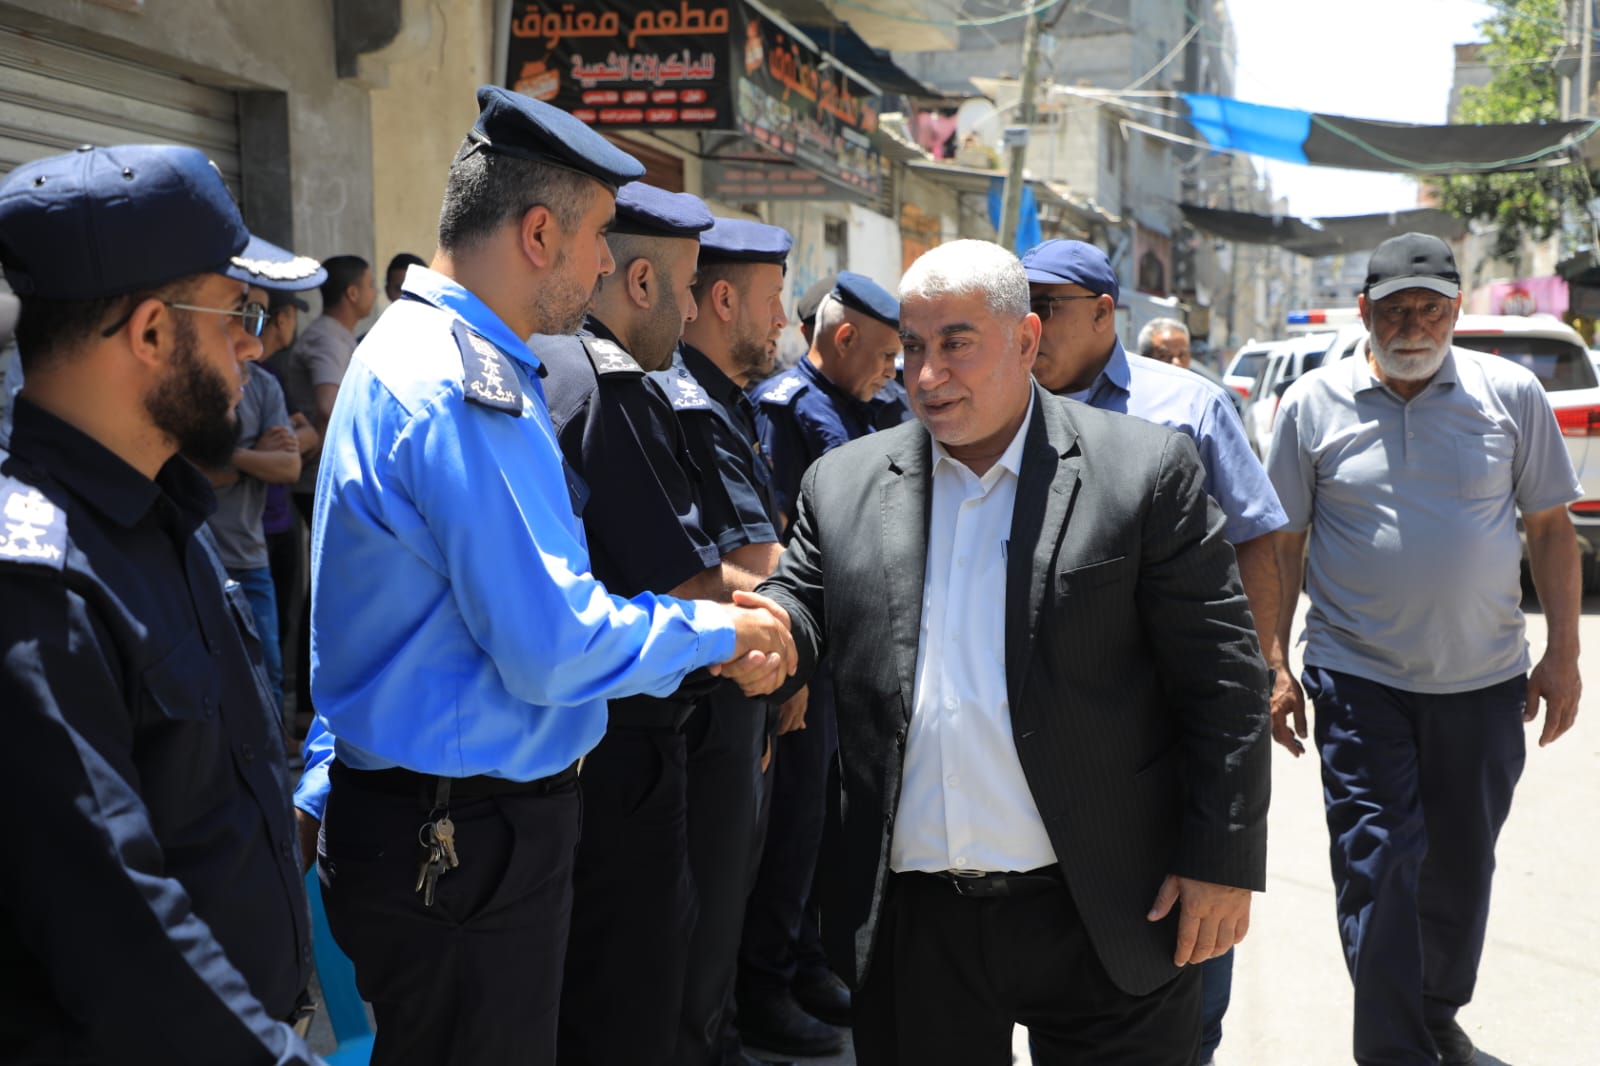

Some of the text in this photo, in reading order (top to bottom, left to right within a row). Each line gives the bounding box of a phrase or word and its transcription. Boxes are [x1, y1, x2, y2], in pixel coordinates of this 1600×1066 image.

[512, 1, 728, 49] مطعم معتوق
[570, 51, 630, 88] الشعبية
